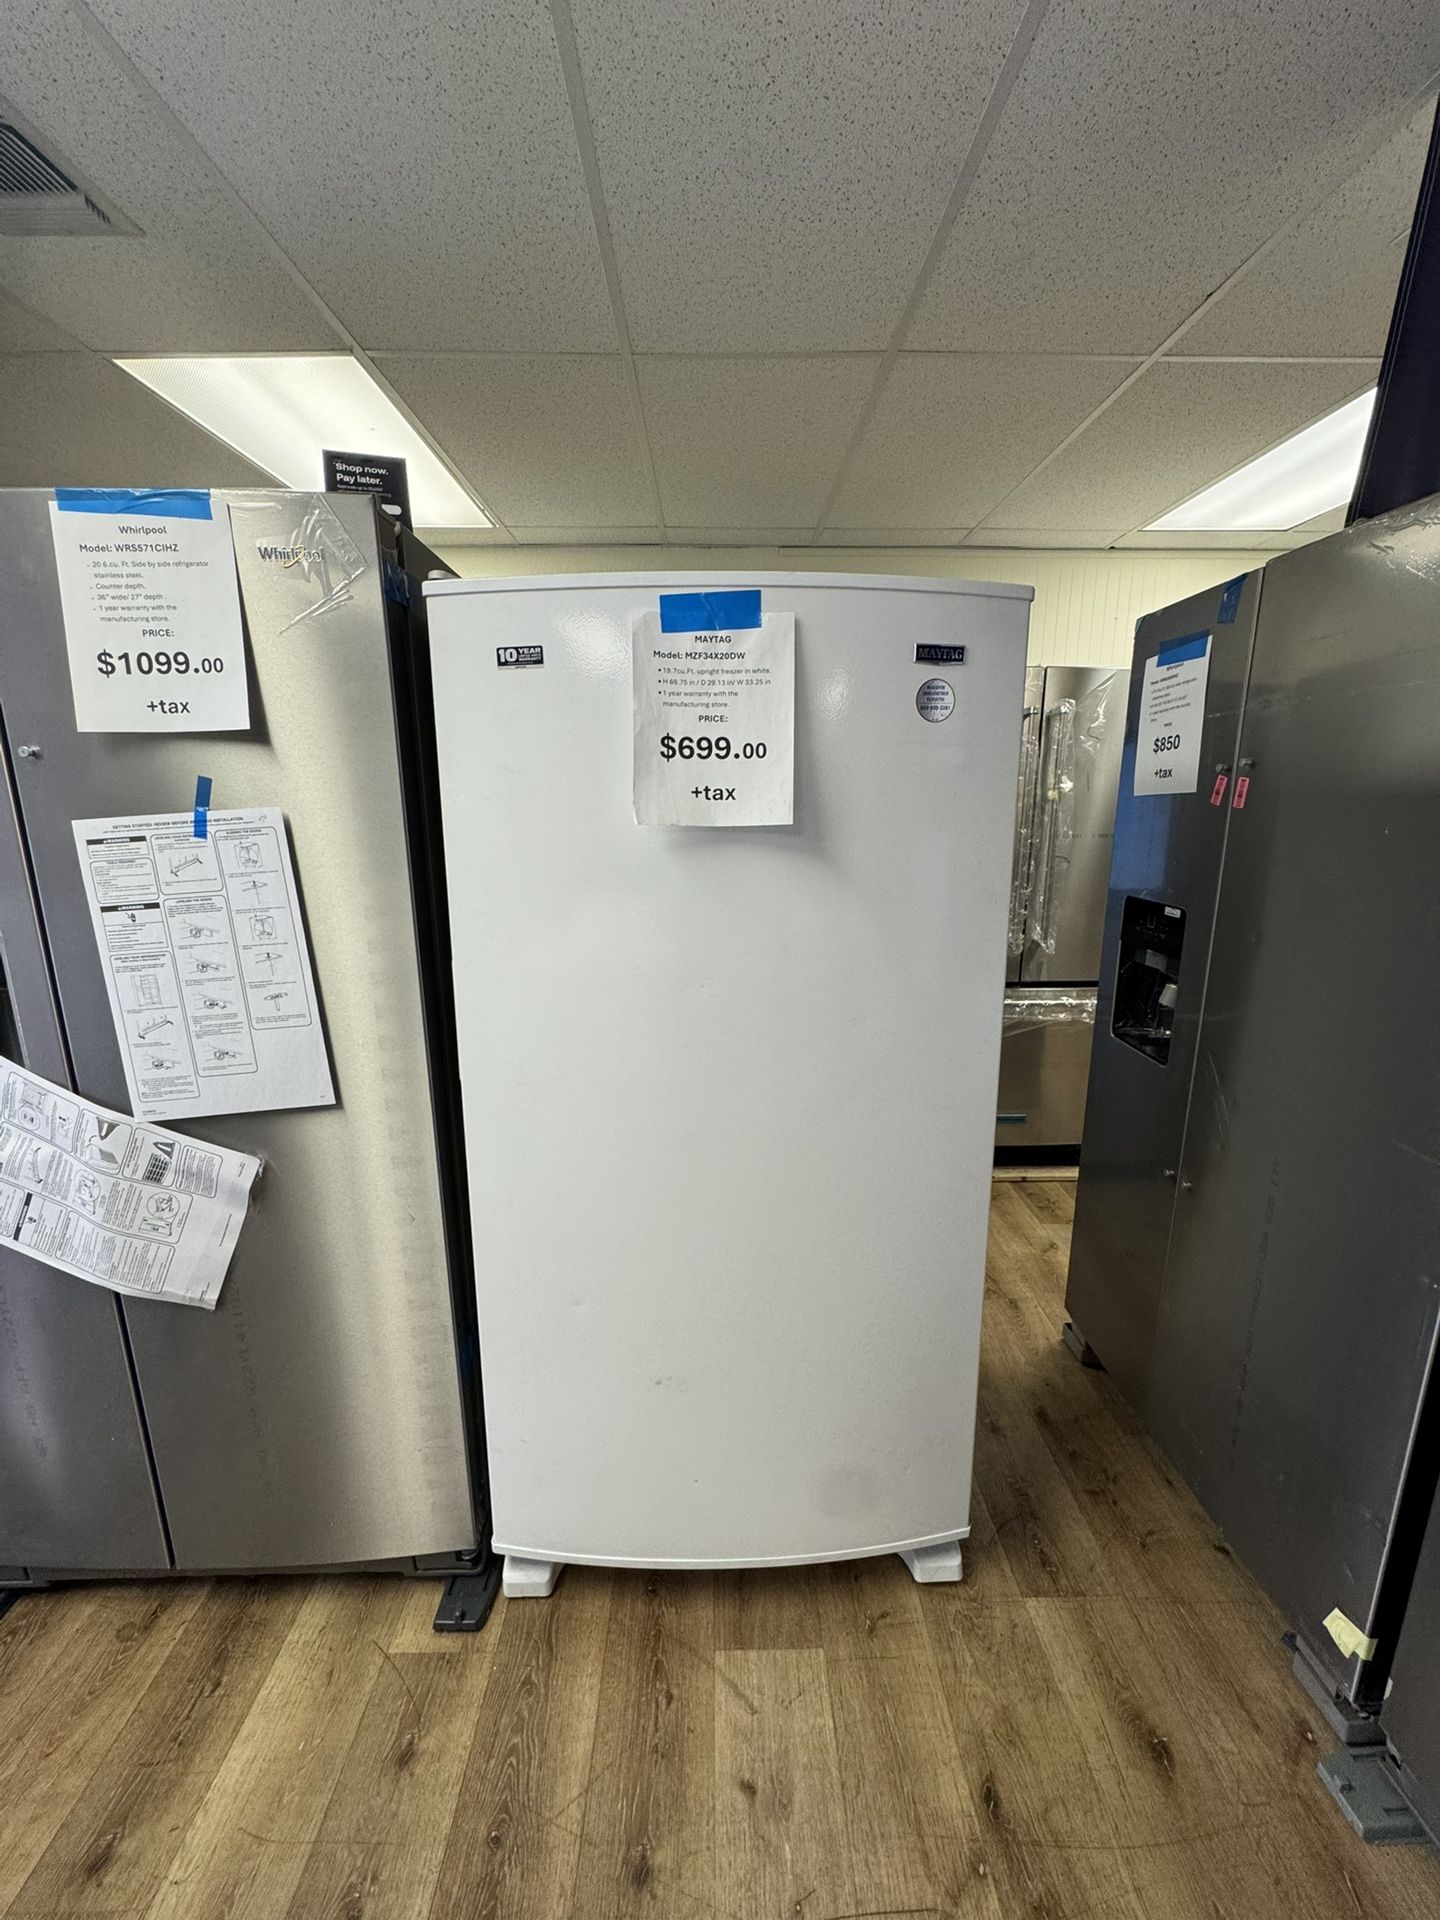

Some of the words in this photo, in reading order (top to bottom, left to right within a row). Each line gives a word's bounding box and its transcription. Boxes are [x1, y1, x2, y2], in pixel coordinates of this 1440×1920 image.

[335, 462, 363, 474] Shop
[364, 466, 389, 475] now.
[336, 473, 355, 484] Pay
[357, 475, 383, 485] later.
[118, 525, 167, 535] Whirlpool
[79, 544, 113, 553] Model:
[257, 545, 324, 568] Whirlpool
[147, 561, 156, 569] by
[142, 629, 175, 637] PRICE:
[694, 635, 732, 643] MAYTAG
[498, 648, 518, 662] 10
[653, 650, 683, 660] Model:
[685, 651, 746, 660] MZF34X20DW
[918, 647, 963, 659] MAYTAG
[96, 648, 224, 678] $1099.00
[146, 700, 191, 714] +tax
[662, 701, 710, 709] manufacturing
[698, 715, 729, 723] PRICE:
[660, 732, 767, 762] $699.00
[1152, 734, 1181, 754] $850
[1154, 768, 1174, 779] +tax
[691, 785, 736, 801] +tax
